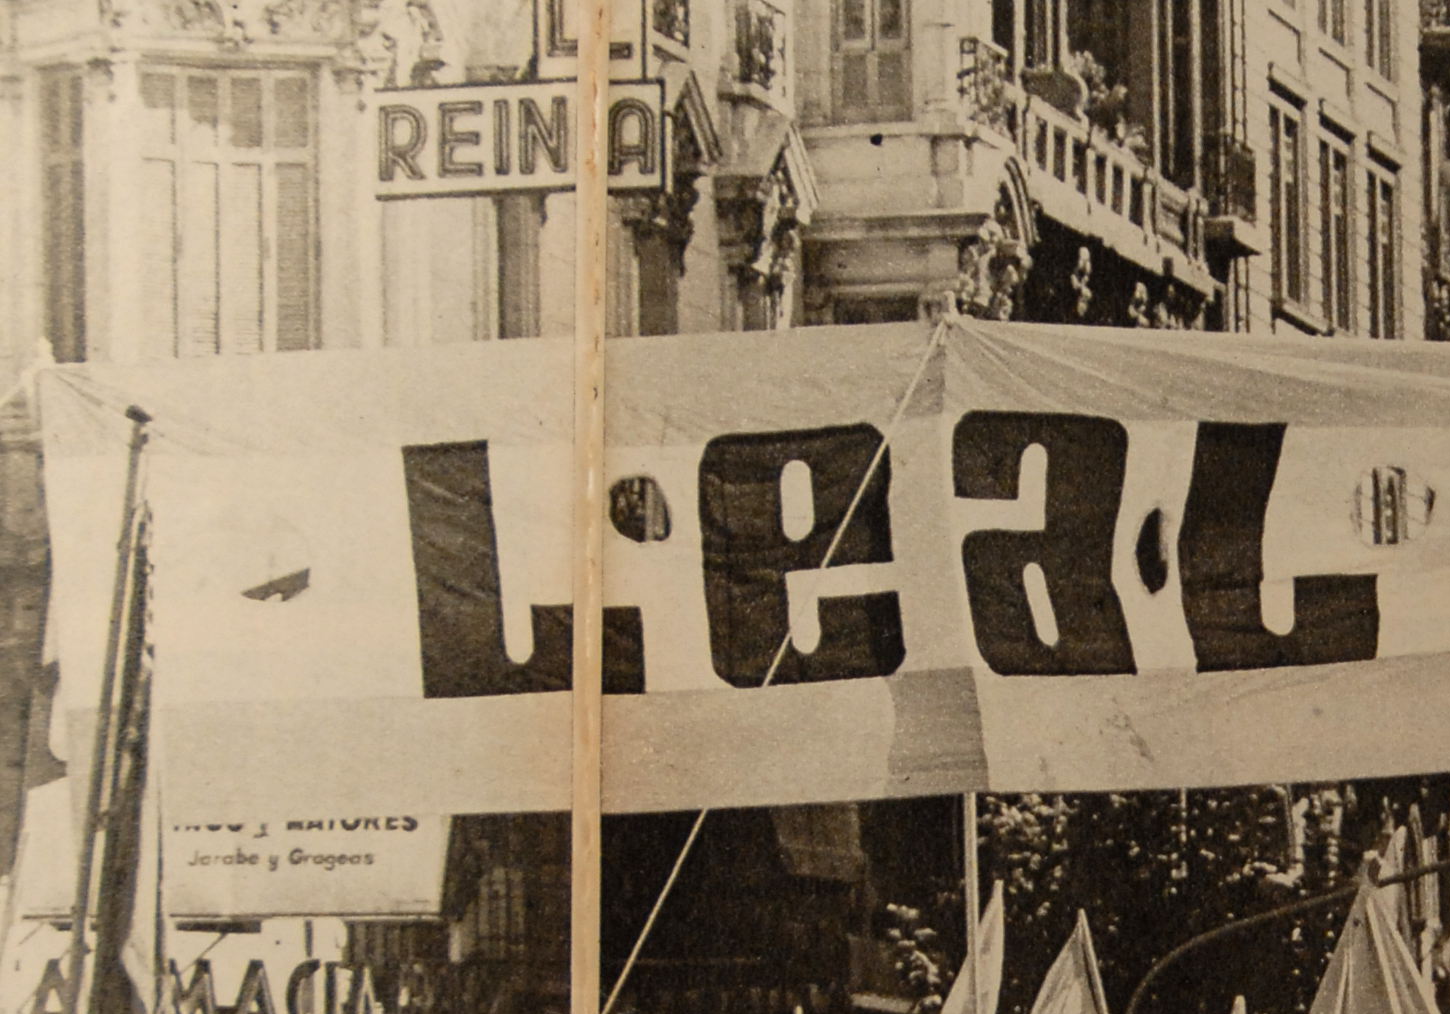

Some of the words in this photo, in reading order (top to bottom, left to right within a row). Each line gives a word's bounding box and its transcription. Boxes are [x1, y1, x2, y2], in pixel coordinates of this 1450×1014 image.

[378, 95, 655, 181] REINA
[188, 848, 258, 866] Jarabe
[268, 857, 279, 872] y
[289, 848, 374, 871] Grageas
